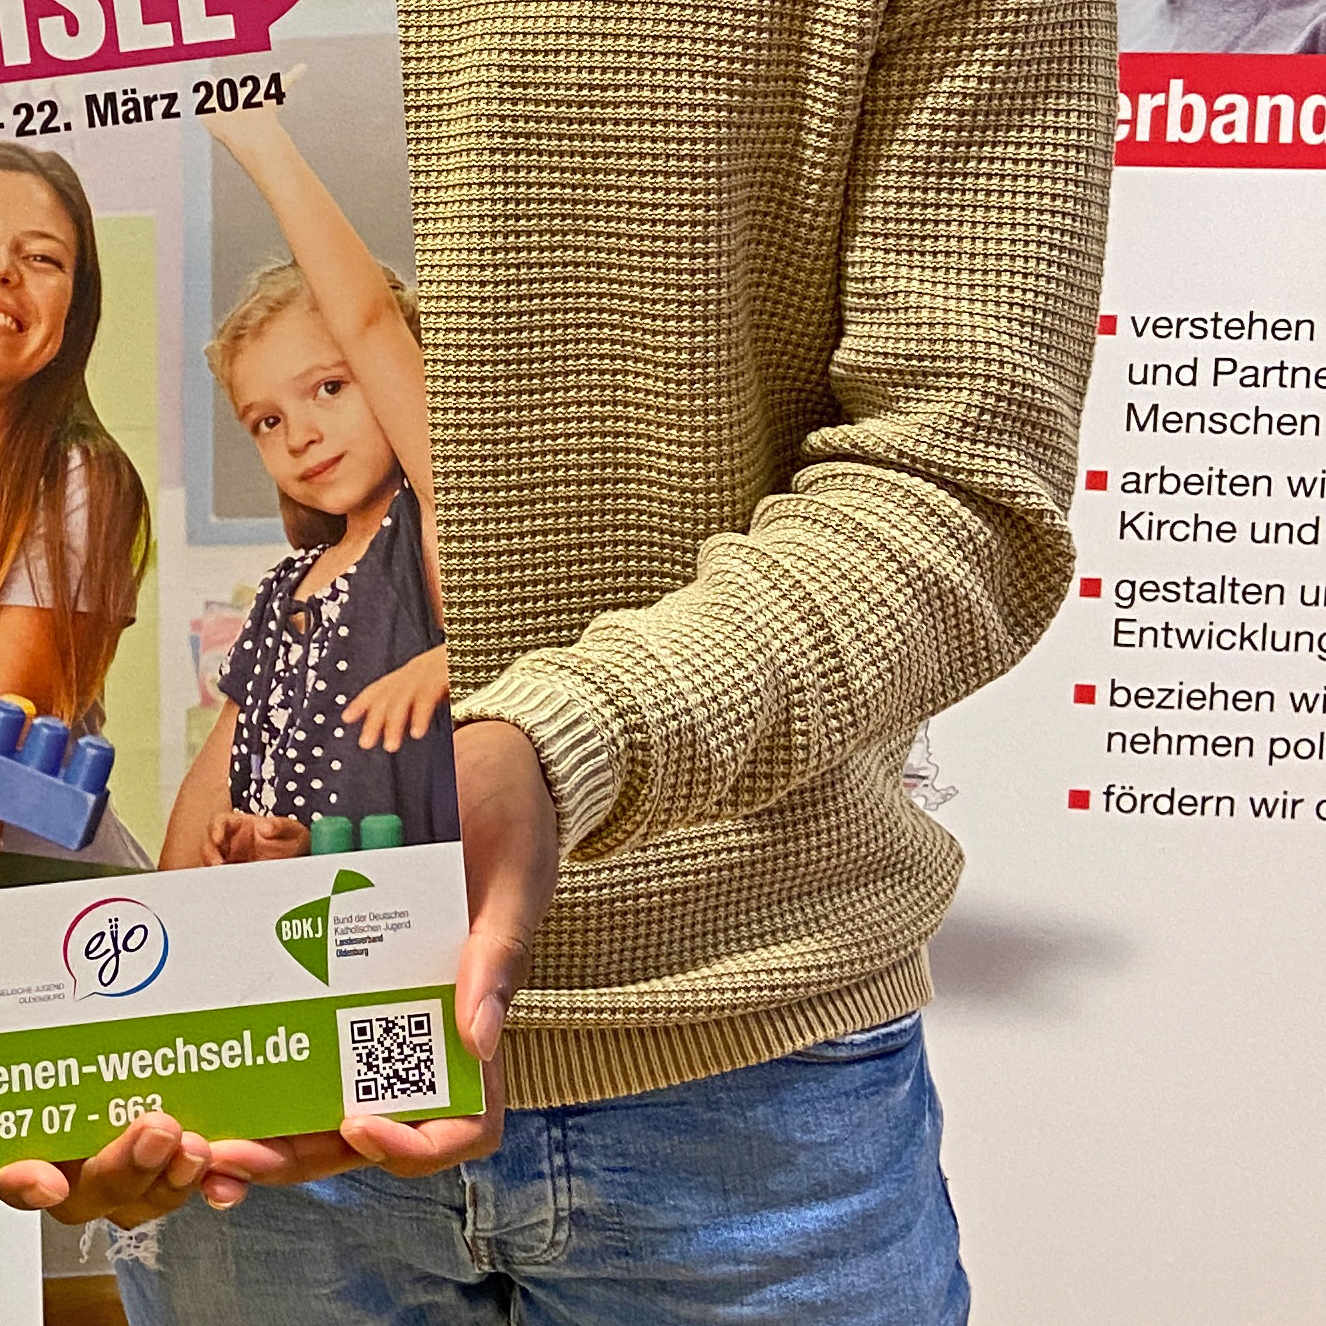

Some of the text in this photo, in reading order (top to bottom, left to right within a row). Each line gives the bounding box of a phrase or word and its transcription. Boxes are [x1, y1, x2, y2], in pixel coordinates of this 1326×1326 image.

[13, 98, 73, 138] 22.
[84, 87, 180, 129] März
[192, 71, 286, 115] 2024
[1130, 310, 1315, 341] verstehen
[1128, 358, 1198, 387] und
[1125, 402, 1320, 436] Menschen
[1120, 465, 1272, 498] arbeiten
[1119, 511, 1320, 545] Kirche und
[1114, 575, 1285, 609] gestalten
[1109, 678, 1274, 713] beziehen
[1106, 725, 1325, 766] nehmen pol
[1103, 784, 1234, 817] fördern
[1250, 790, 1305, 819] wir
[281, 916, 323, 941] BDKJ
[333, 909, 409, 925] Bund der Deutschen
[383, 920, 411, 933] Jugend
